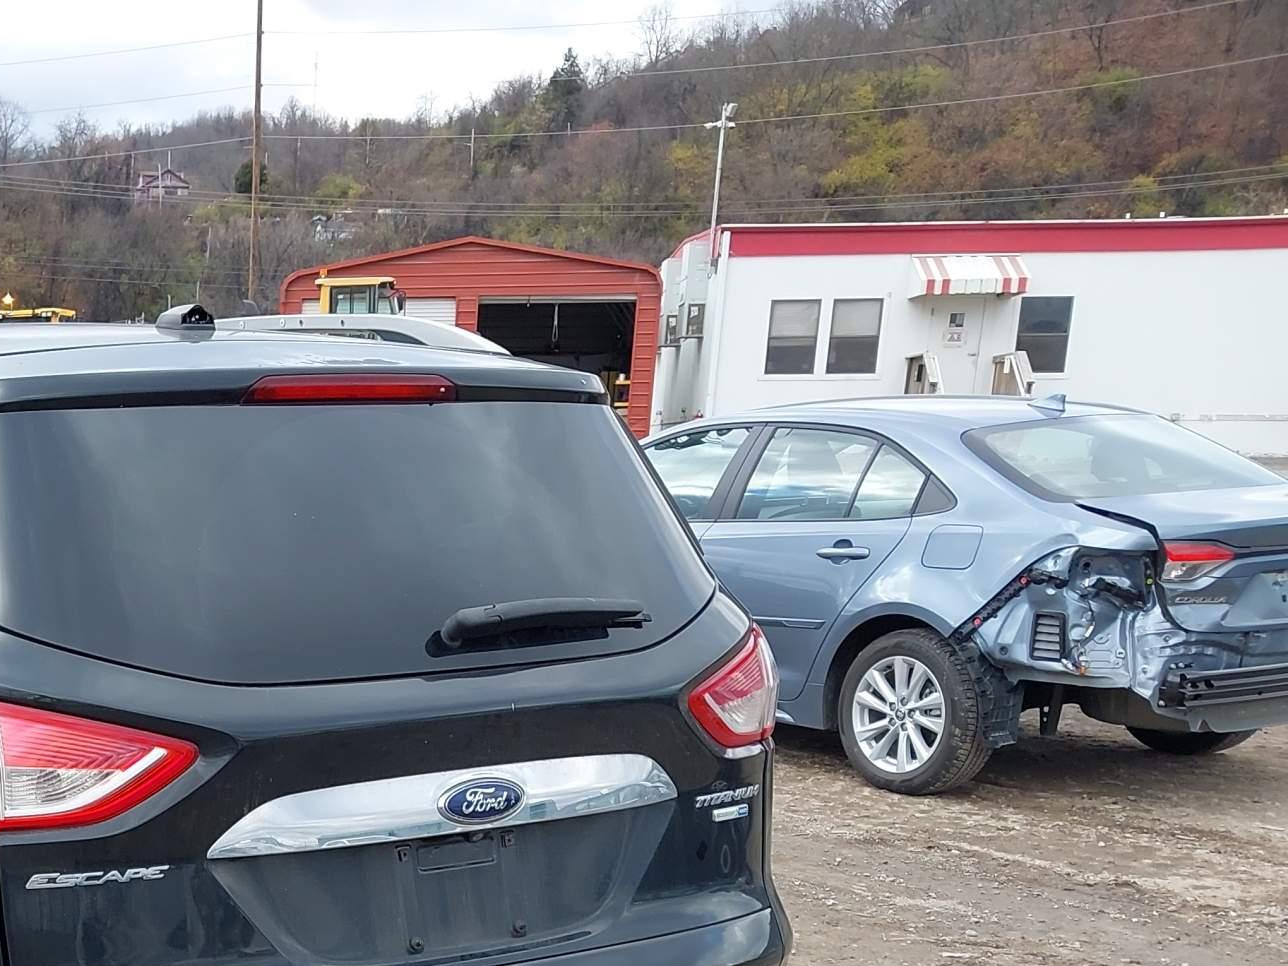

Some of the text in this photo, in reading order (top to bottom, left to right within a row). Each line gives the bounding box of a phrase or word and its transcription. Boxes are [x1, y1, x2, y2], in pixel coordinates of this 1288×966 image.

[462, 787, 508, 815] Ford
[695, 783, 760, 808] TITANIUM
[25, 865, 170, 890] ESCAPE
